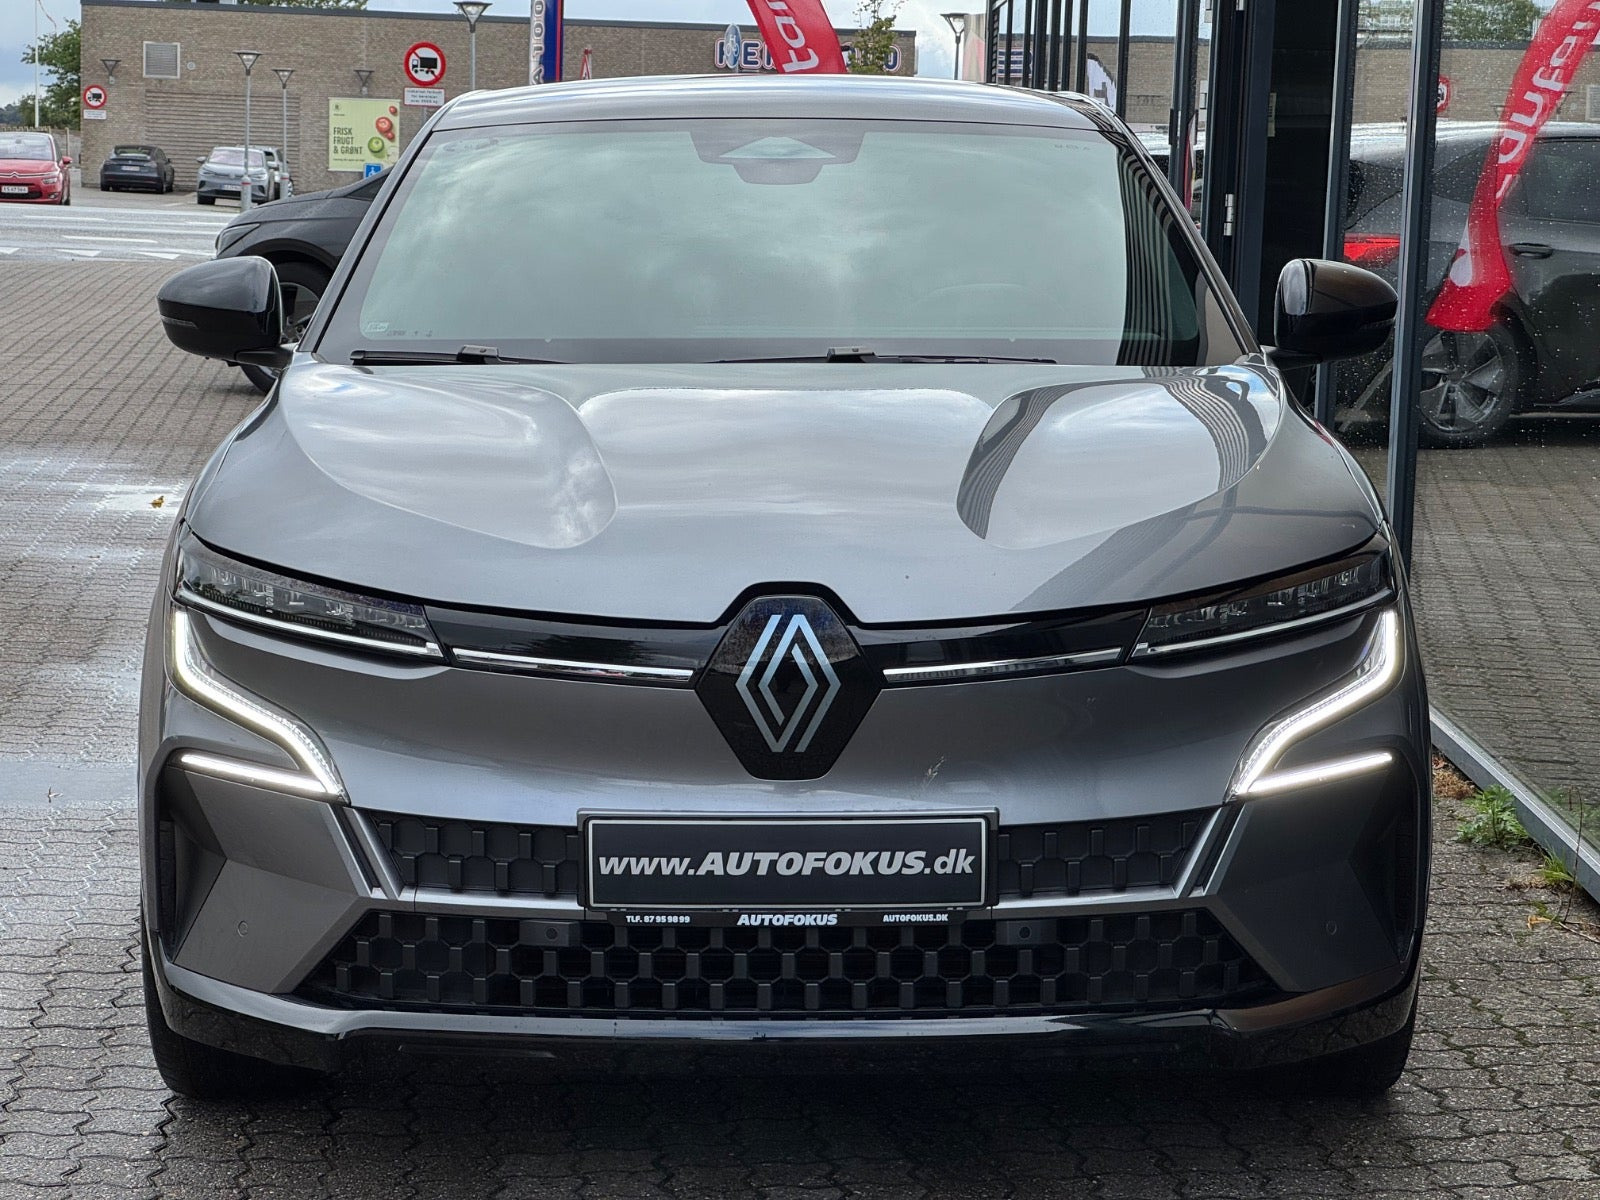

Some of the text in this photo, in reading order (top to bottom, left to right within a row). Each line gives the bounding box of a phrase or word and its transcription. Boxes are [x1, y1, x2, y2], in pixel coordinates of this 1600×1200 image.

[333, 127, 352, 136] FRISK
[333, 137, 354, 145] FRUGT
[333, 146, 339, 154] &
[599, 849, 976, 876] www.AUTOFOKUS.dk
[625, 915, 643, 923] TLF.
[736, 914, 838, 926] AUTOFOKUS
[883, 914, 949, 923] AUTOFOKUS.DK
